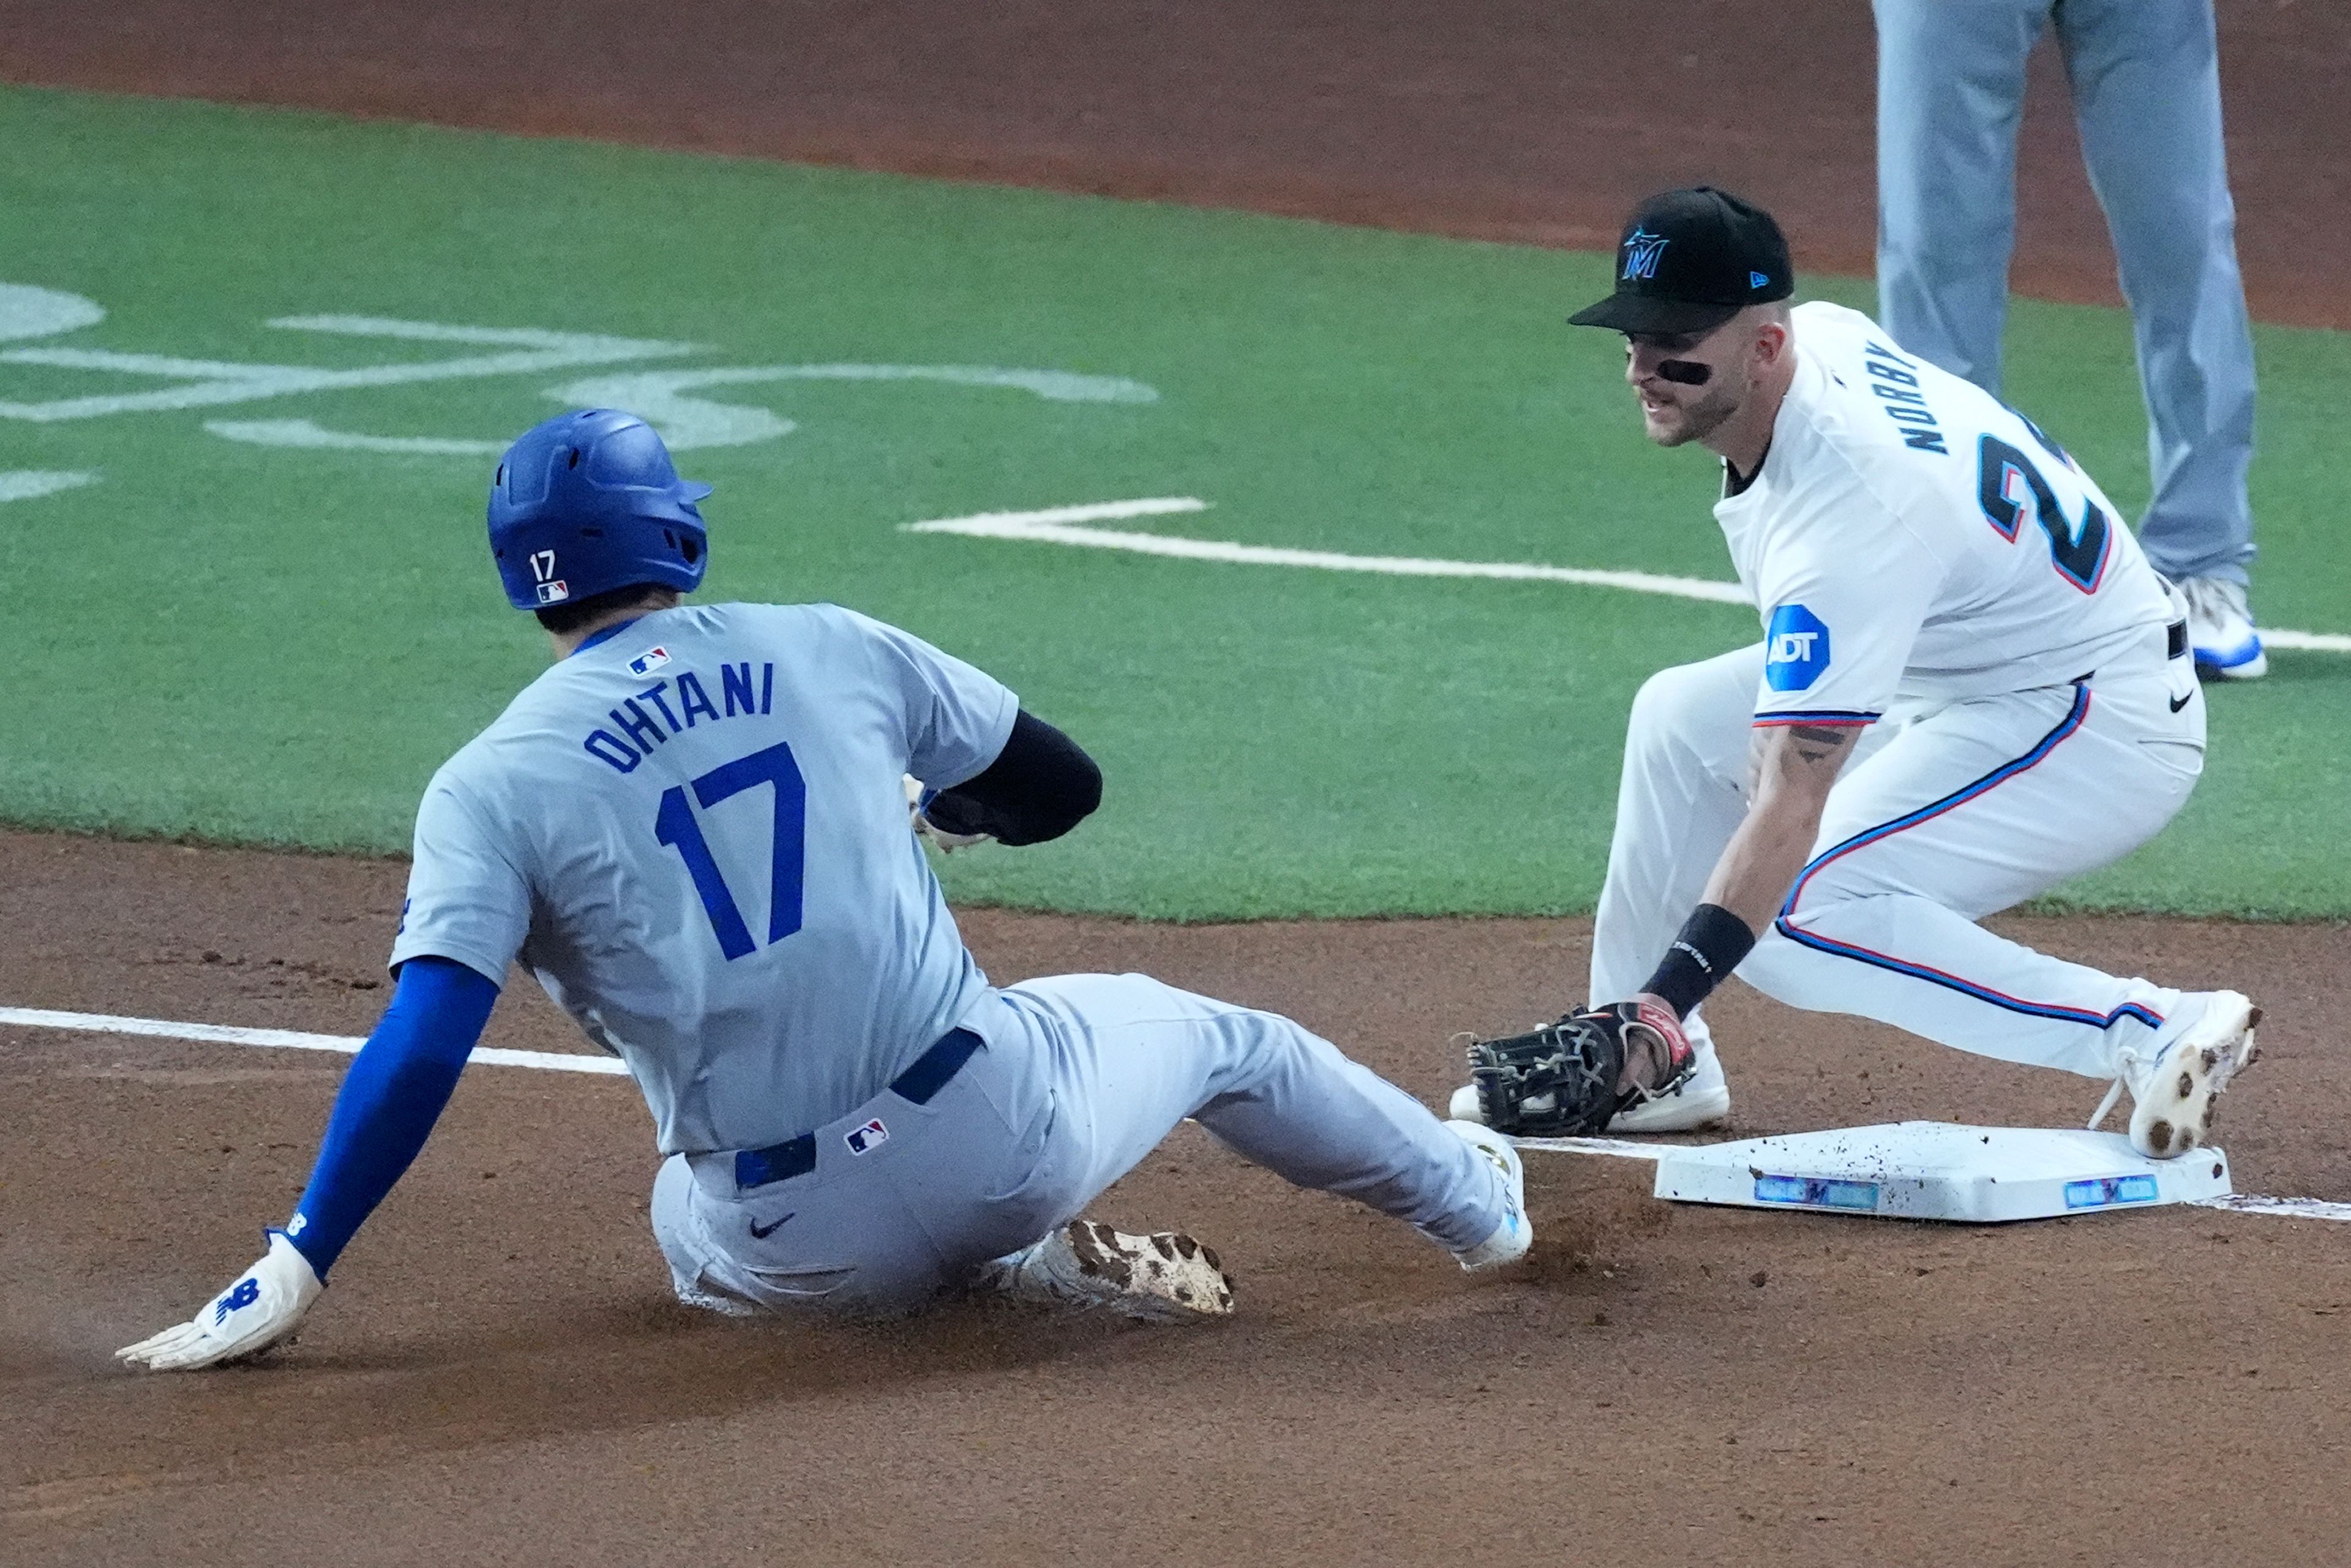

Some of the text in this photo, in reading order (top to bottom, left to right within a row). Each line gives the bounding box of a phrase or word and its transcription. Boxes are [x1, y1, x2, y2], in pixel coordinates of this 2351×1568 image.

[1865, 339, 1949, 456] NORBY
[1976, 404, 2112, 595] 2
[530, 549, 555, 582] 17
[1768, 632, 1818, 666] ADT
[584, 661, 773, 774] OHTANI
[654, 741, 806, 962] 17
